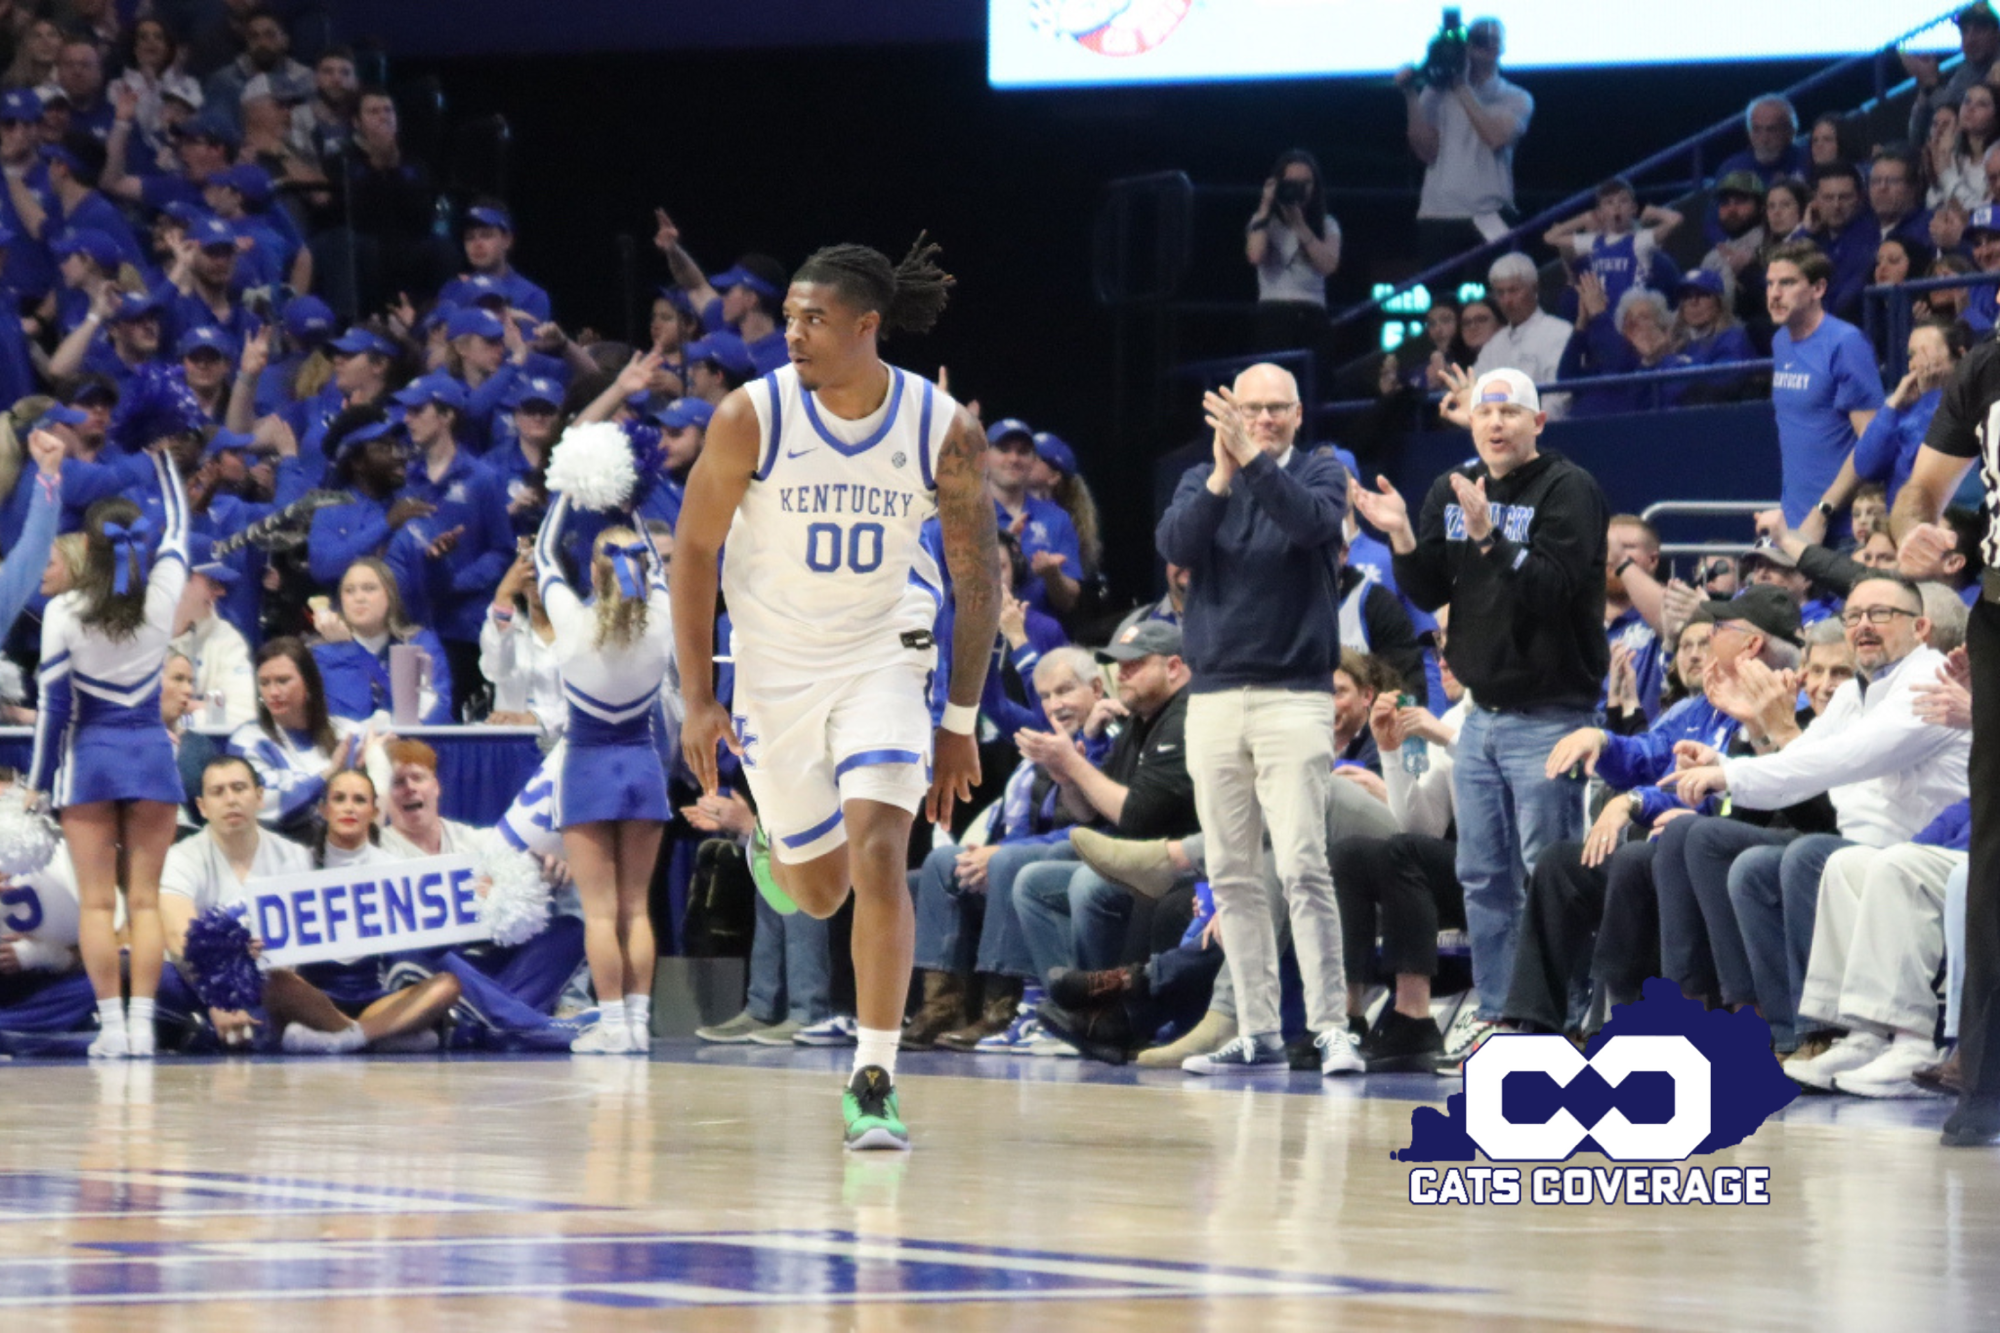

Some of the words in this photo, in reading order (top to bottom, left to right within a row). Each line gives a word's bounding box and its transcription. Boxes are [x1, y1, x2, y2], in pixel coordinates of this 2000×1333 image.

[780, 483, 914, 518] KENTUCKY
[805, 521, 885, 574] 00
[255, 867, 481, 950] DEFENSE
